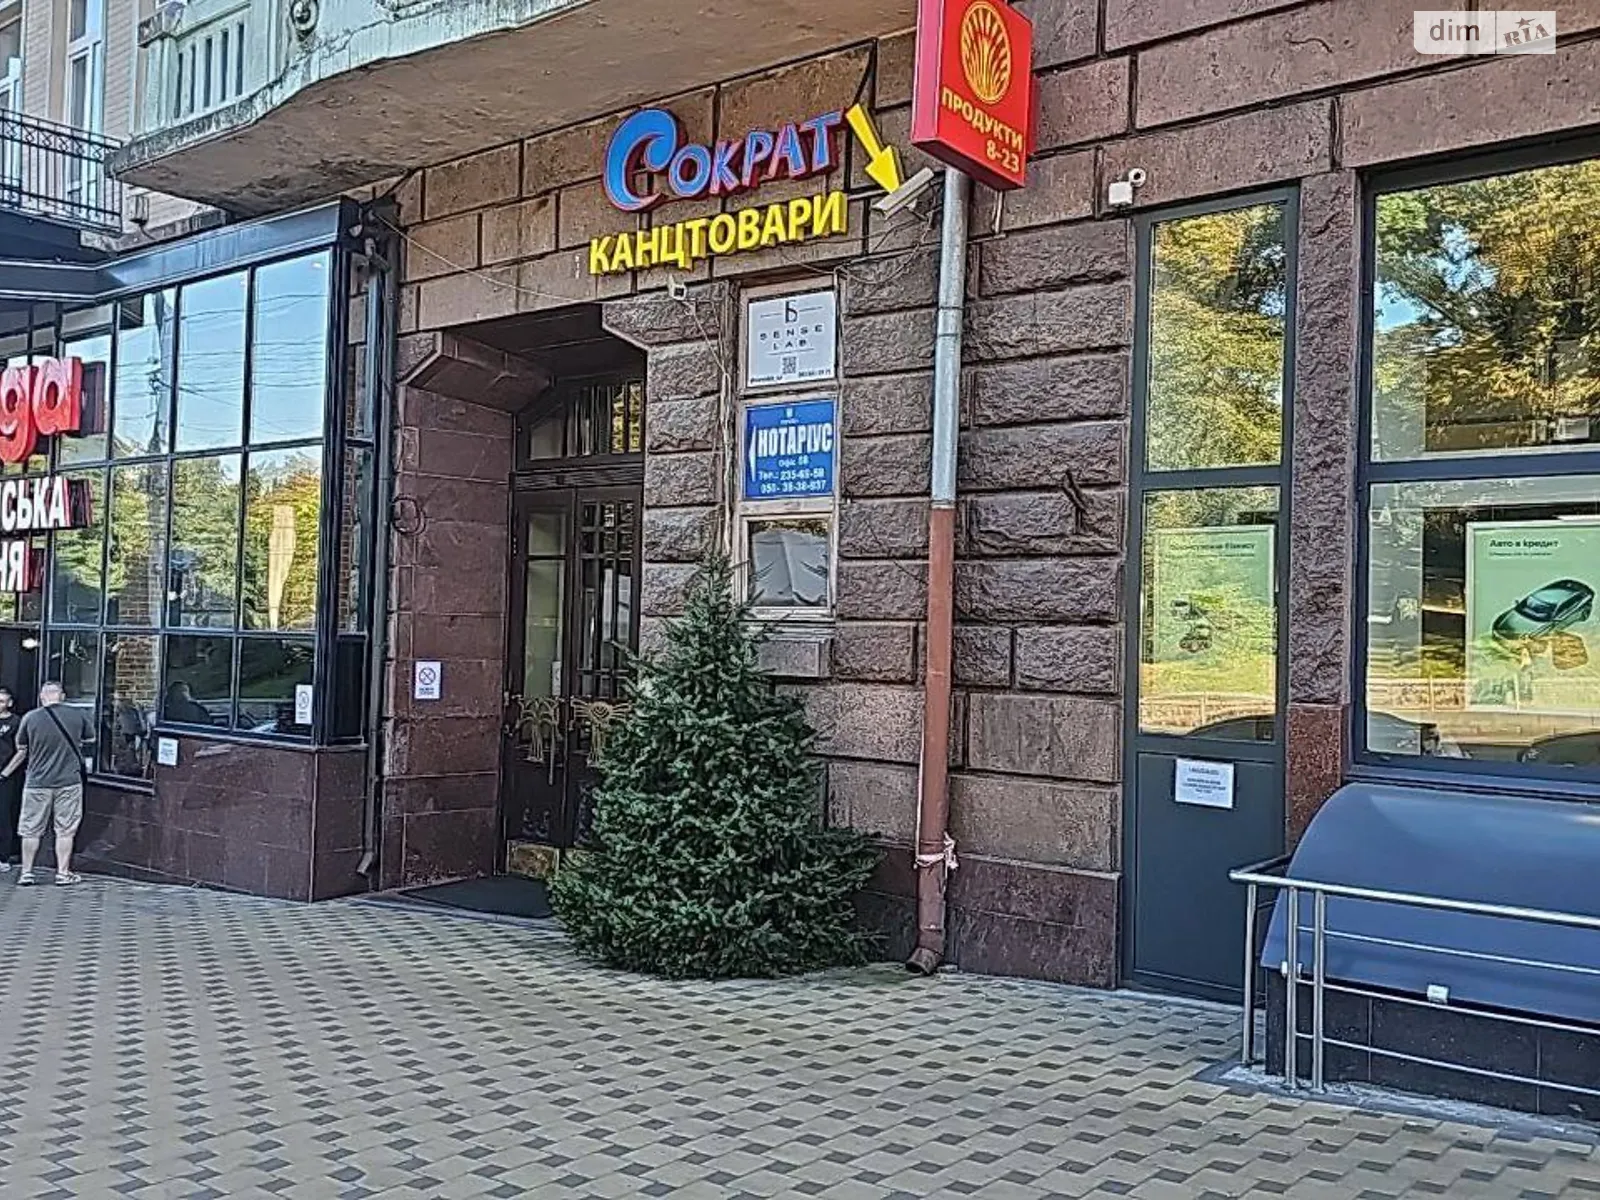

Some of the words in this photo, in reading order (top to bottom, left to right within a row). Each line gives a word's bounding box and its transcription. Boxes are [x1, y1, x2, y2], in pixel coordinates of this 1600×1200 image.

[941, 86, 1023, 151] ПРОДУКТИ
[985, 139, 1020, 173] 8-23
[589, 191, 847, 275] КАНЦТОВАРИ
[757, 422, 833, 458] НОТАРІУС
[0, 475, 67, 533] СЬКА
